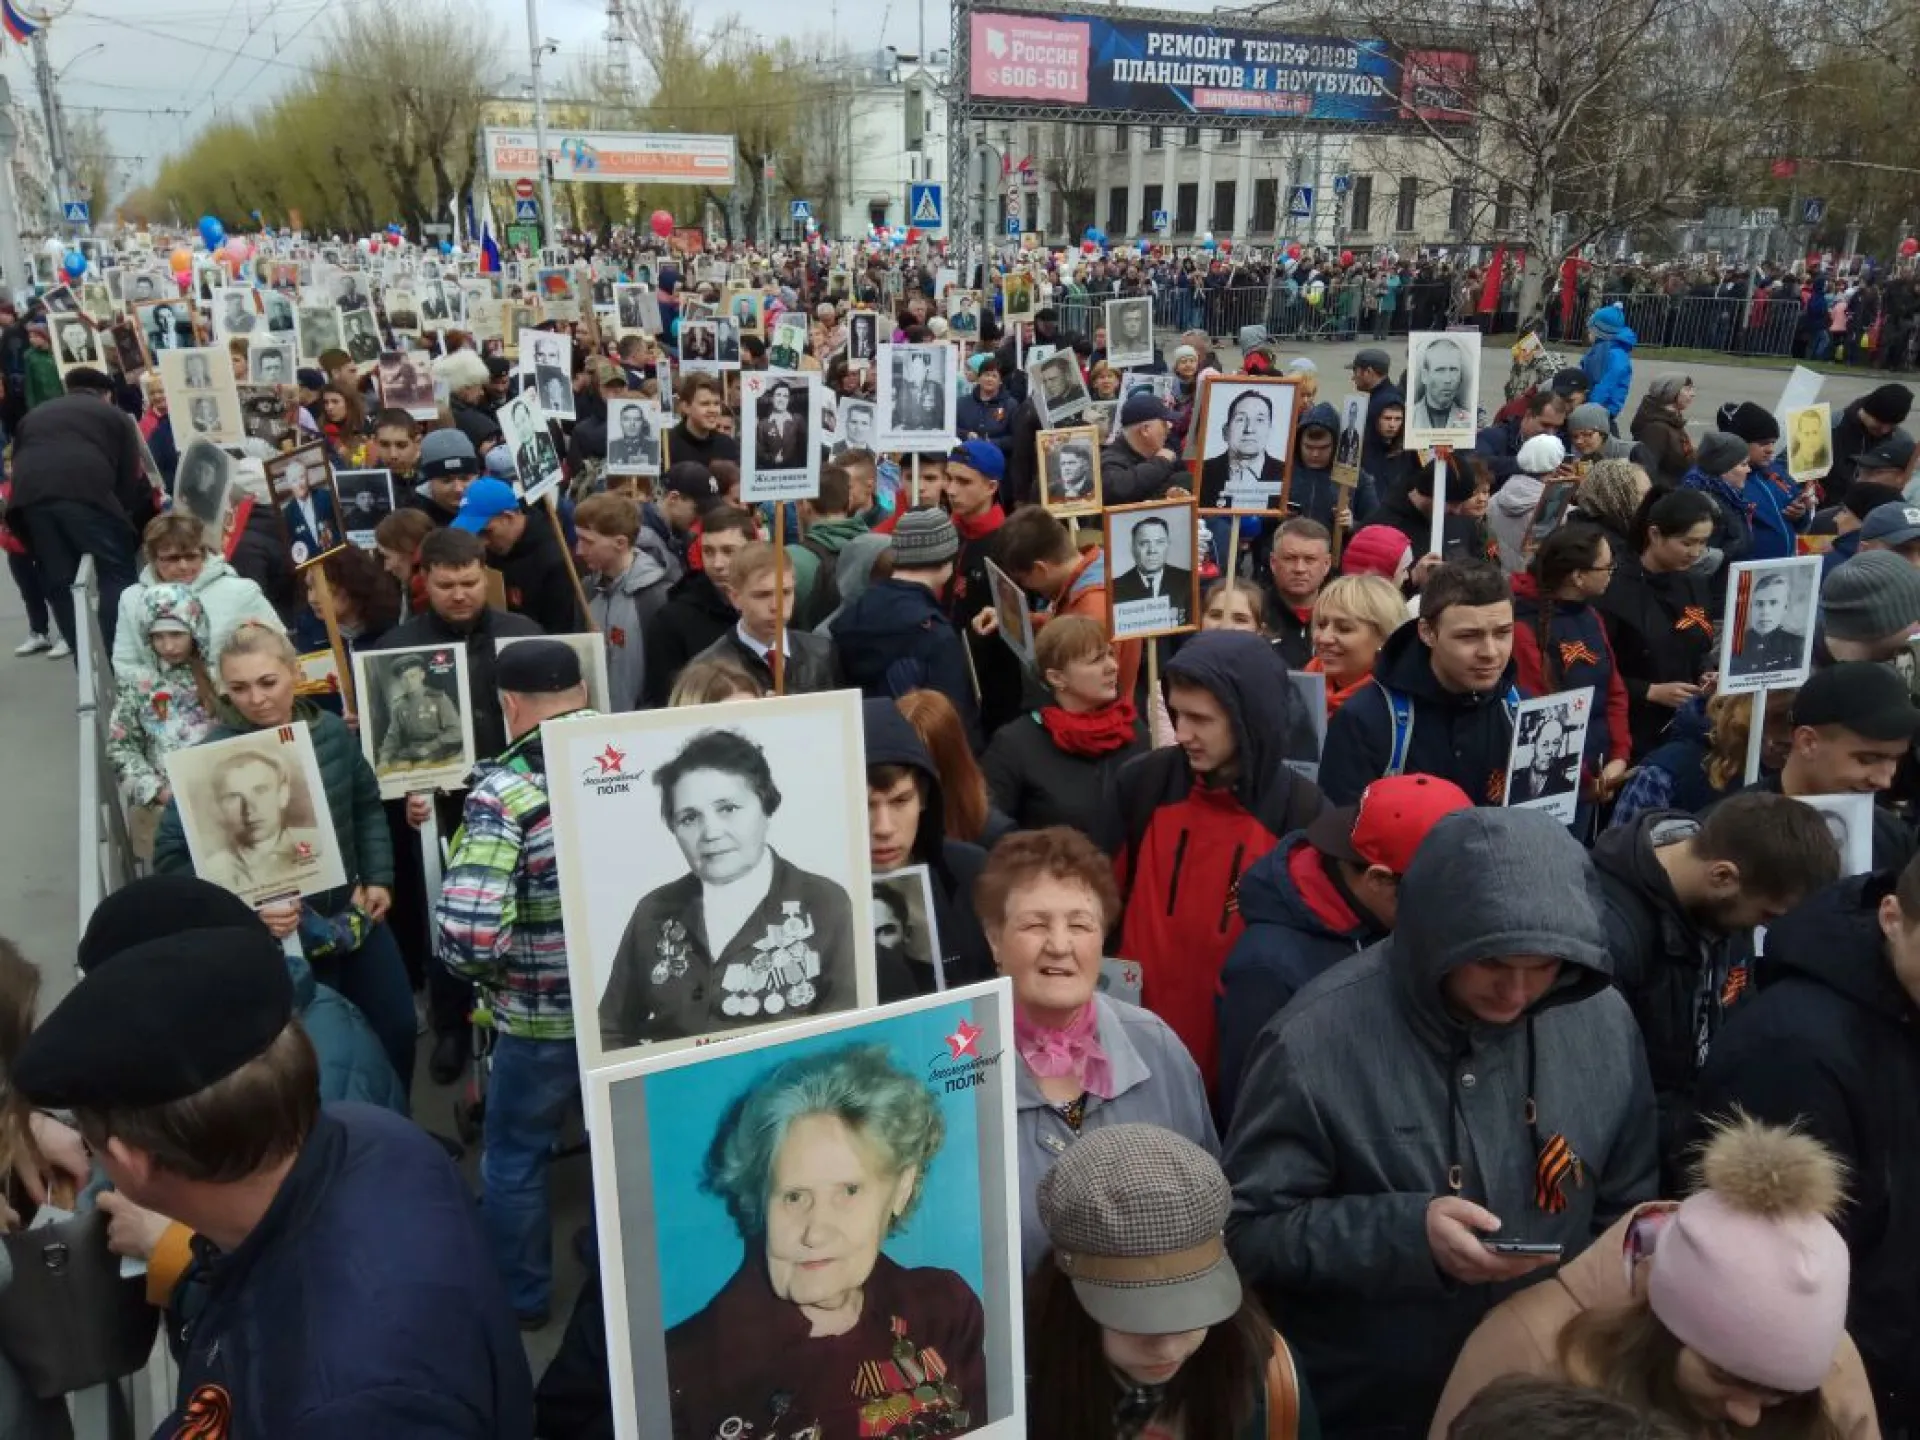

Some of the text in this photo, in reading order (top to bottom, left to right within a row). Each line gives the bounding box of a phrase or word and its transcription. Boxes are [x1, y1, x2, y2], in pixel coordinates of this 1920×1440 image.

[1147, 32, 1358, 69] РЕМОНТ ТЕЛЕФОНОВ
[1002, 66, 1078, 90] 606-501
[1113, 58, 1243, 88] ПЛАНШЕТОВ
[1253, 67, 1268, 89] И
[597, 783, 630, 796] ПОЛК
[945, 1072, 986, 1094] ПОЛК
